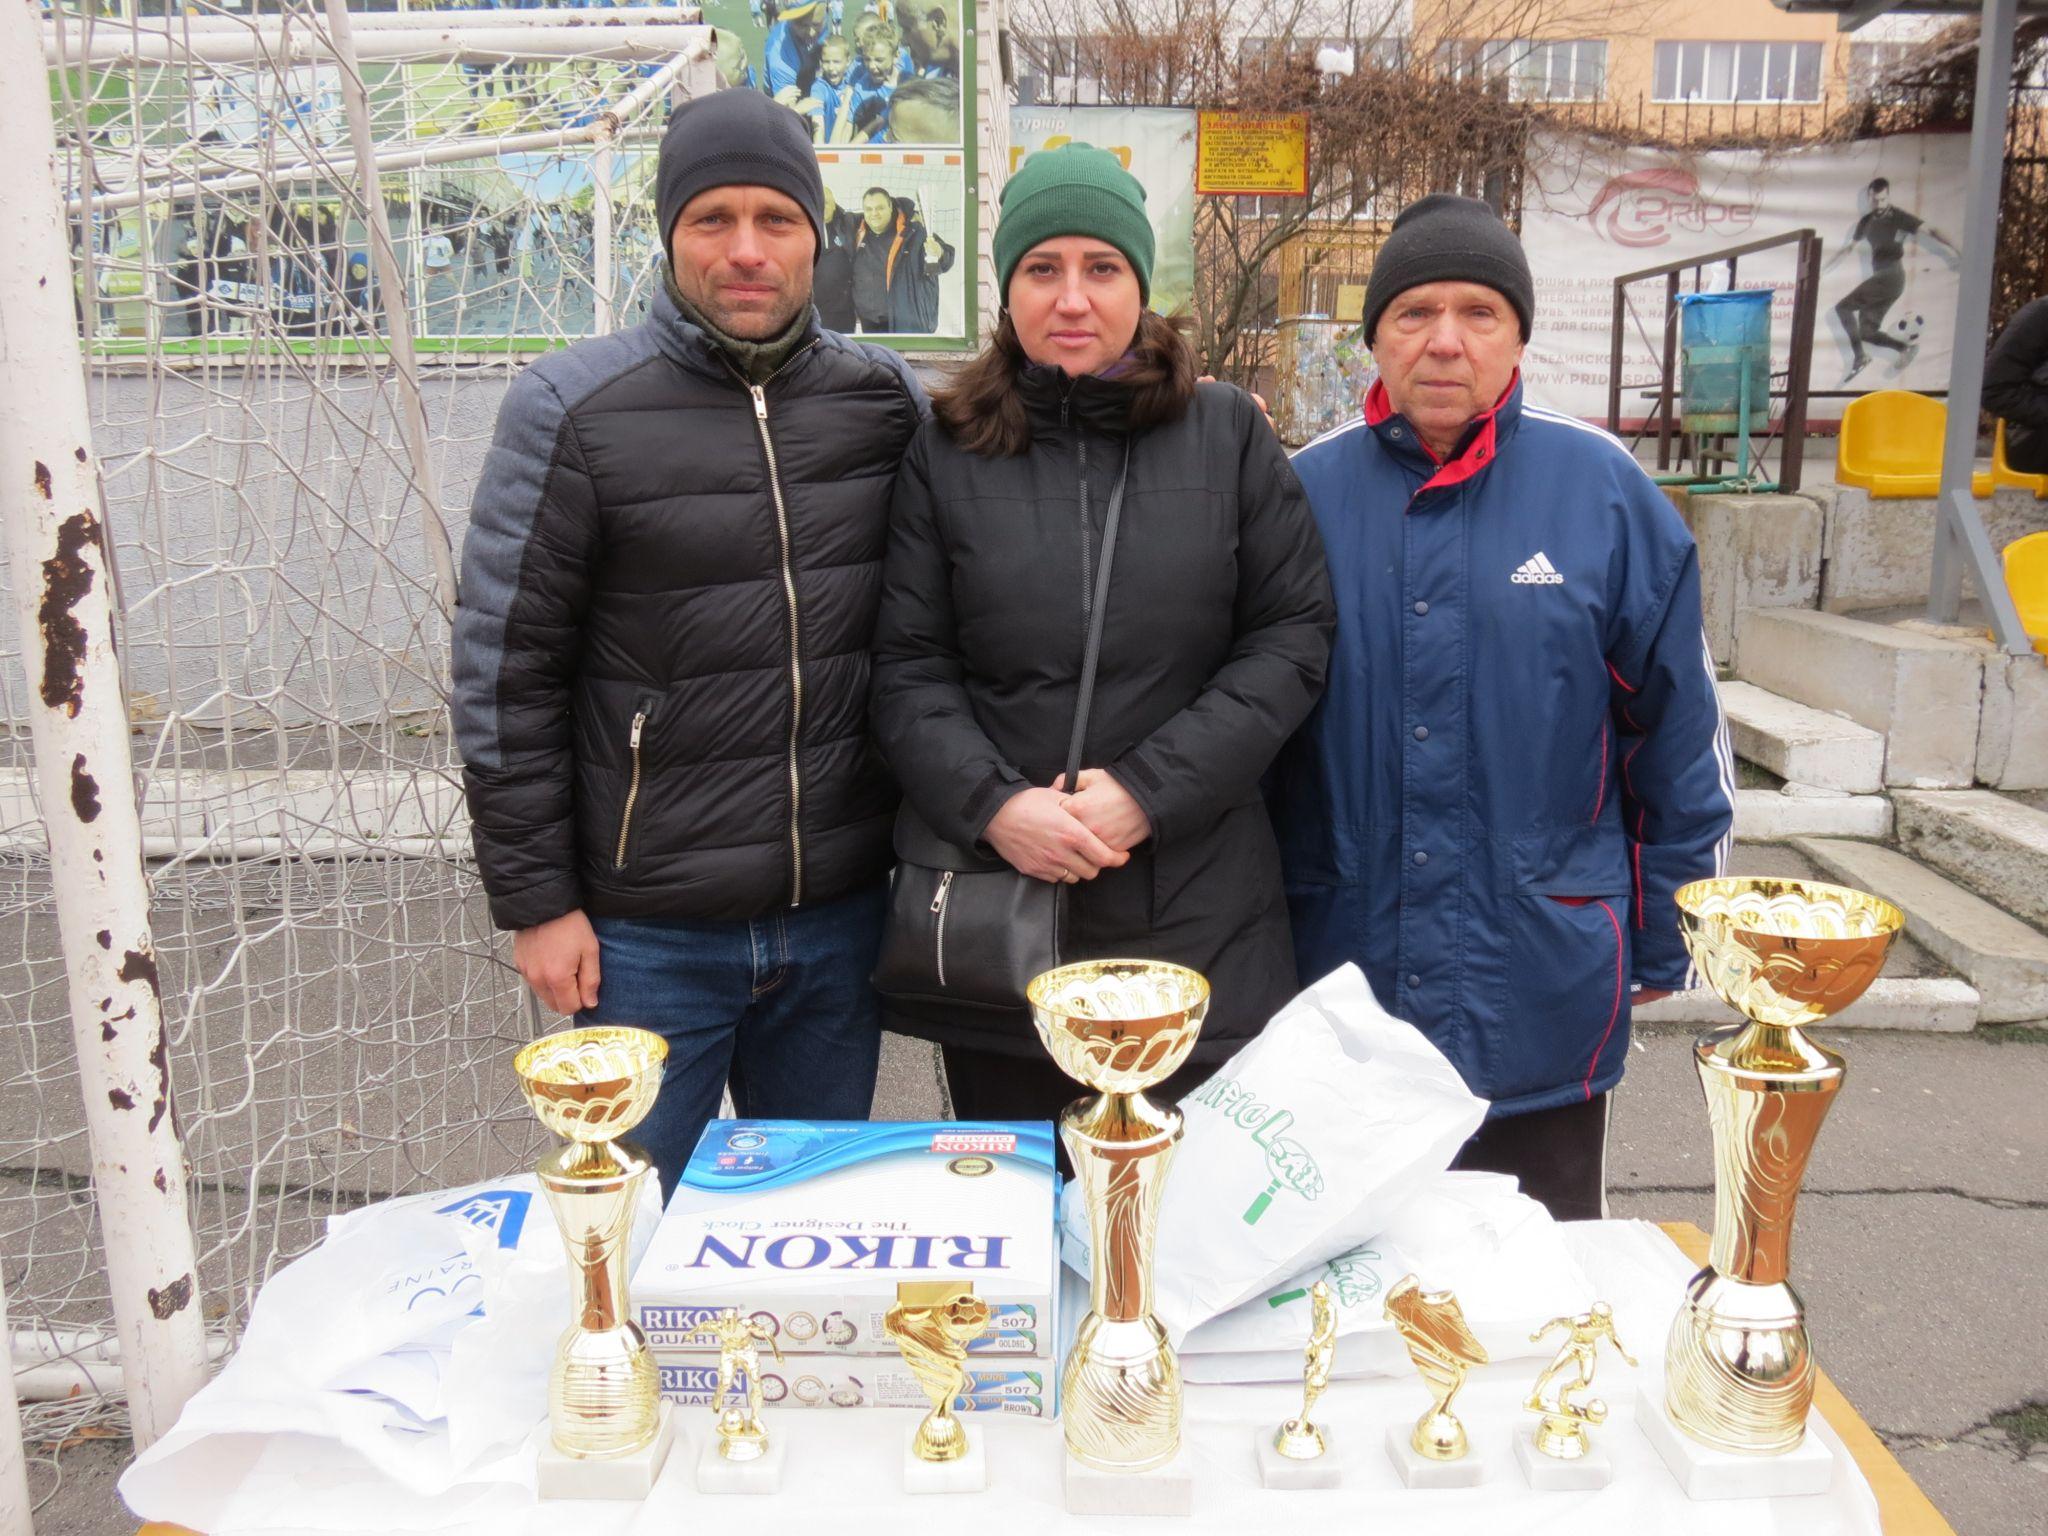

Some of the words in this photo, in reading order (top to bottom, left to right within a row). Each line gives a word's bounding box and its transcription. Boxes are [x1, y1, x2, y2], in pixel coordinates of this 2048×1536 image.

[1532, 278, 1574, 287] ОШИВ
[1551, 321, 1577, 331] ДЛЯ
[1511, 573, 1564, 584] adidas
[936, 1142, 1012, 1152] RIKON
[702, 1220, 763, 1231] Clock
[770, 1219, 863, 1231] Designer
[872, 1220, 911, 1231] The
[684, 1234, 1012, 1270] RIKON
[1001, 1318, 1028, 1328] 507
[650, 1333, 725, 1345] QUART
[1004, 1386, 1031, 1395] 507
[1003, 1404, 1033, 1413] BROWN
